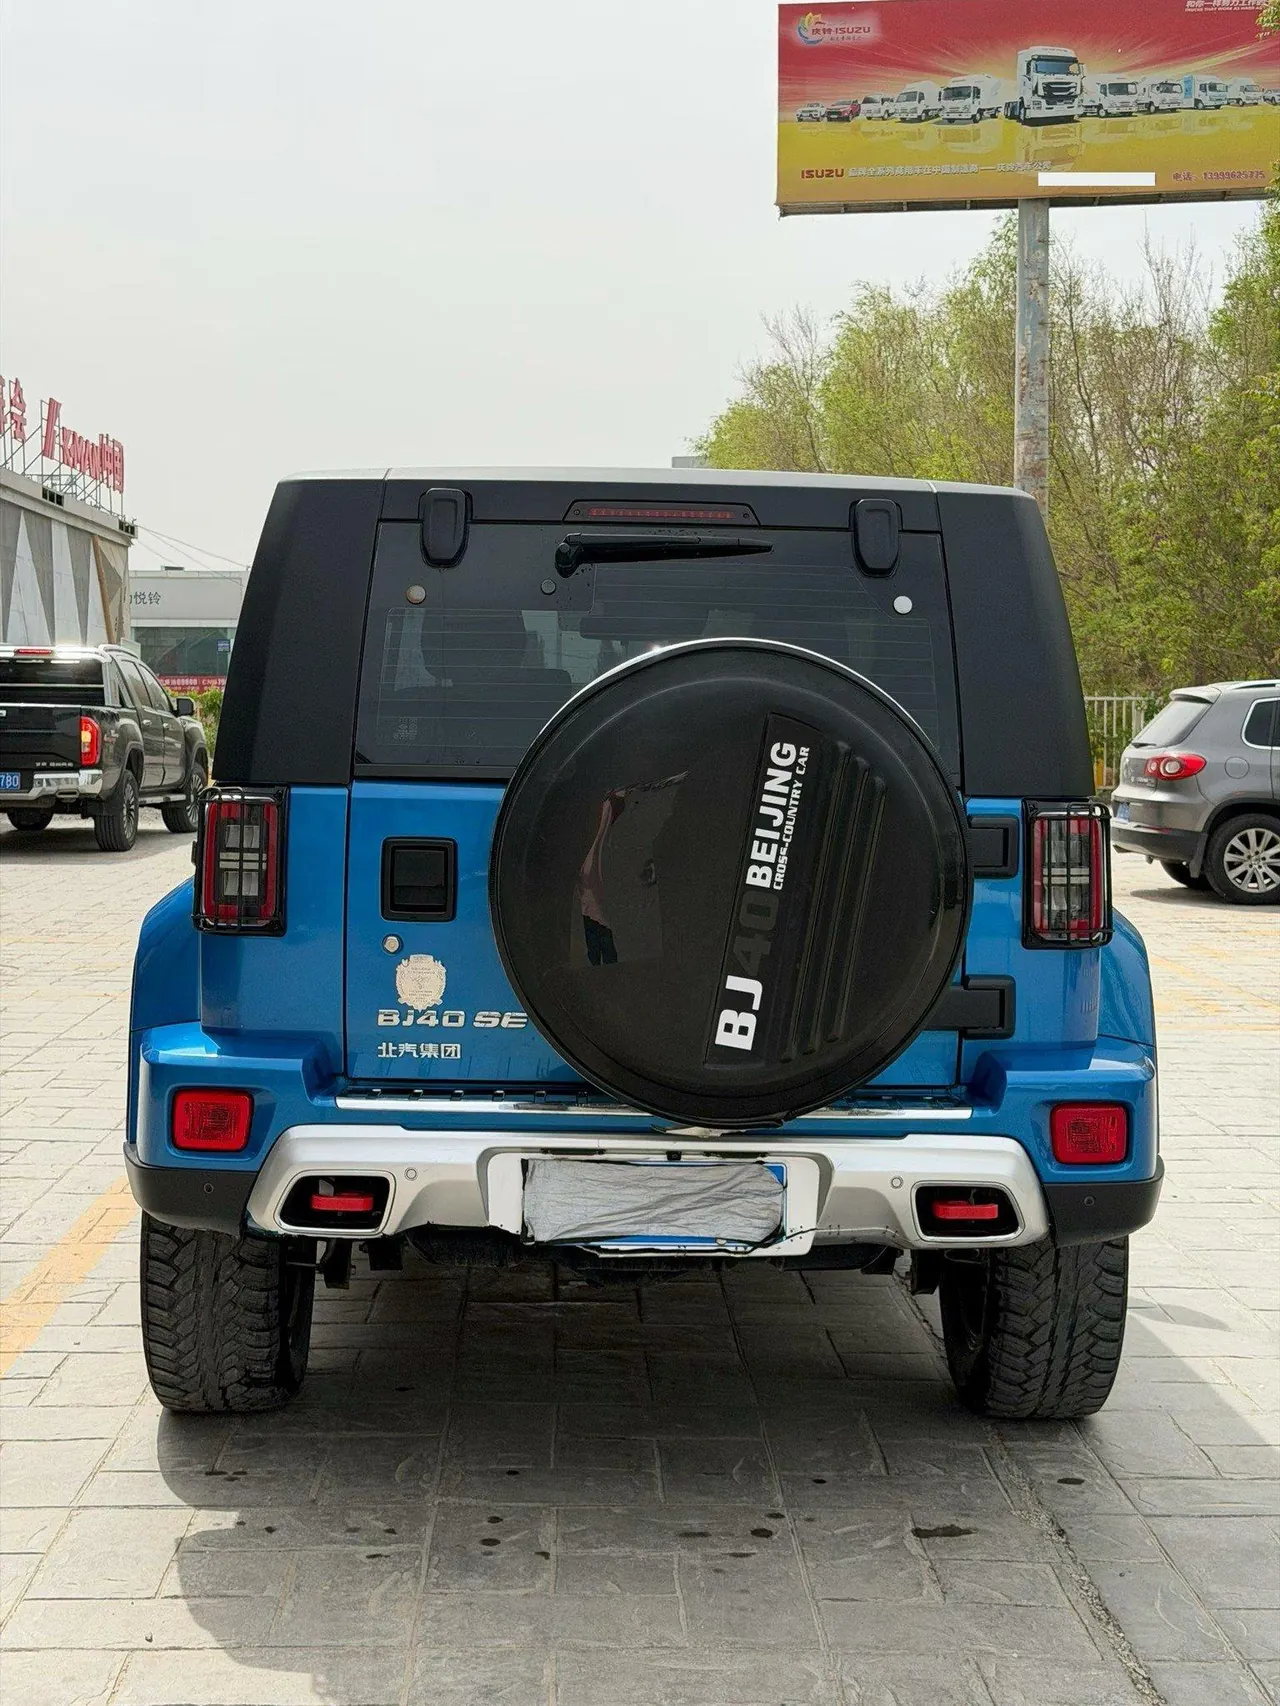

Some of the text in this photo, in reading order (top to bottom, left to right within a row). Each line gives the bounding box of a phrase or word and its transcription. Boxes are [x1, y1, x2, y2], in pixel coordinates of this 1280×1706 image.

[801, 168, 844, 179] ISUZU
[746, 742, 797, 888] BEIJING
[773, 746, 810, 890] CROSS-COUNTRY CAR
[377, 1009, 528, 1029] BJ40 SE
[377, 1042, 461, 1059] 北汽集团
